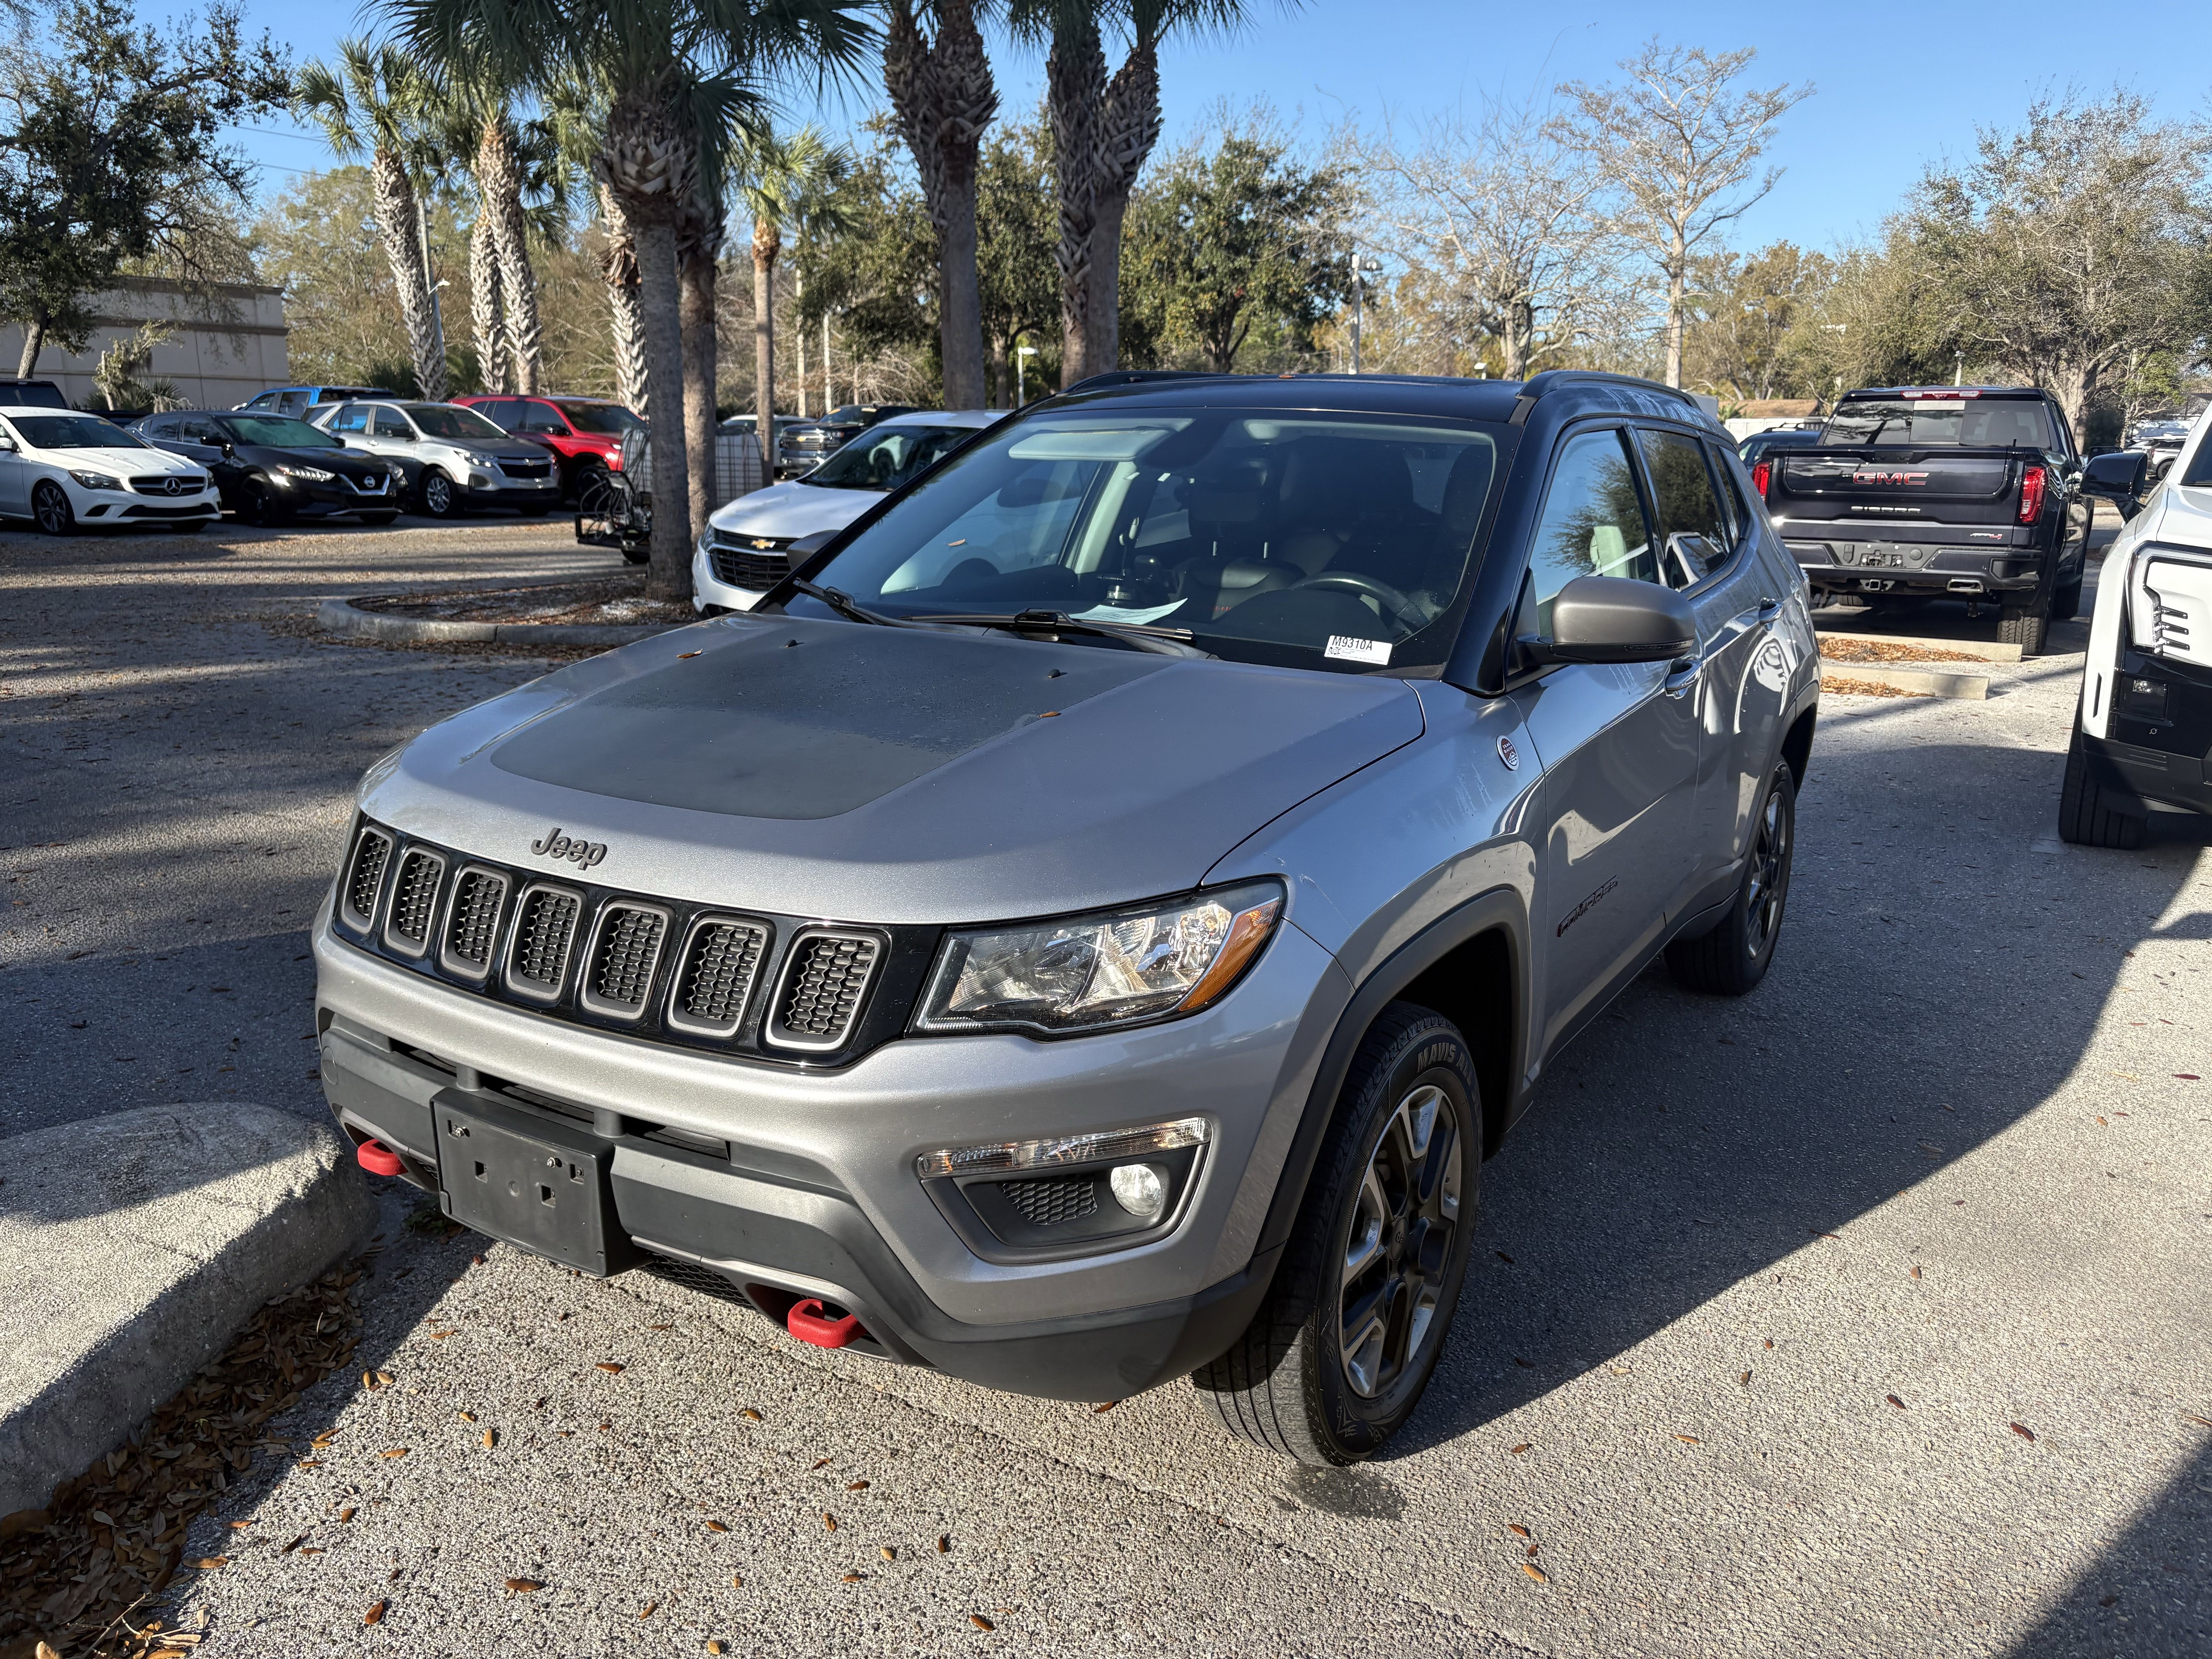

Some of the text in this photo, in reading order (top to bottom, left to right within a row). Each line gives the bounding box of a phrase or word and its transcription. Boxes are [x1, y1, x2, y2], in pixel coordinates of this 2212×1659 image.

[1853, 472, 1929, 486] GMC
[1332, 636, 1372, 651] M9310A
[531, 827, 608, 871] Jeep
[1417, 1042, 1456, 1072] MAVIS
